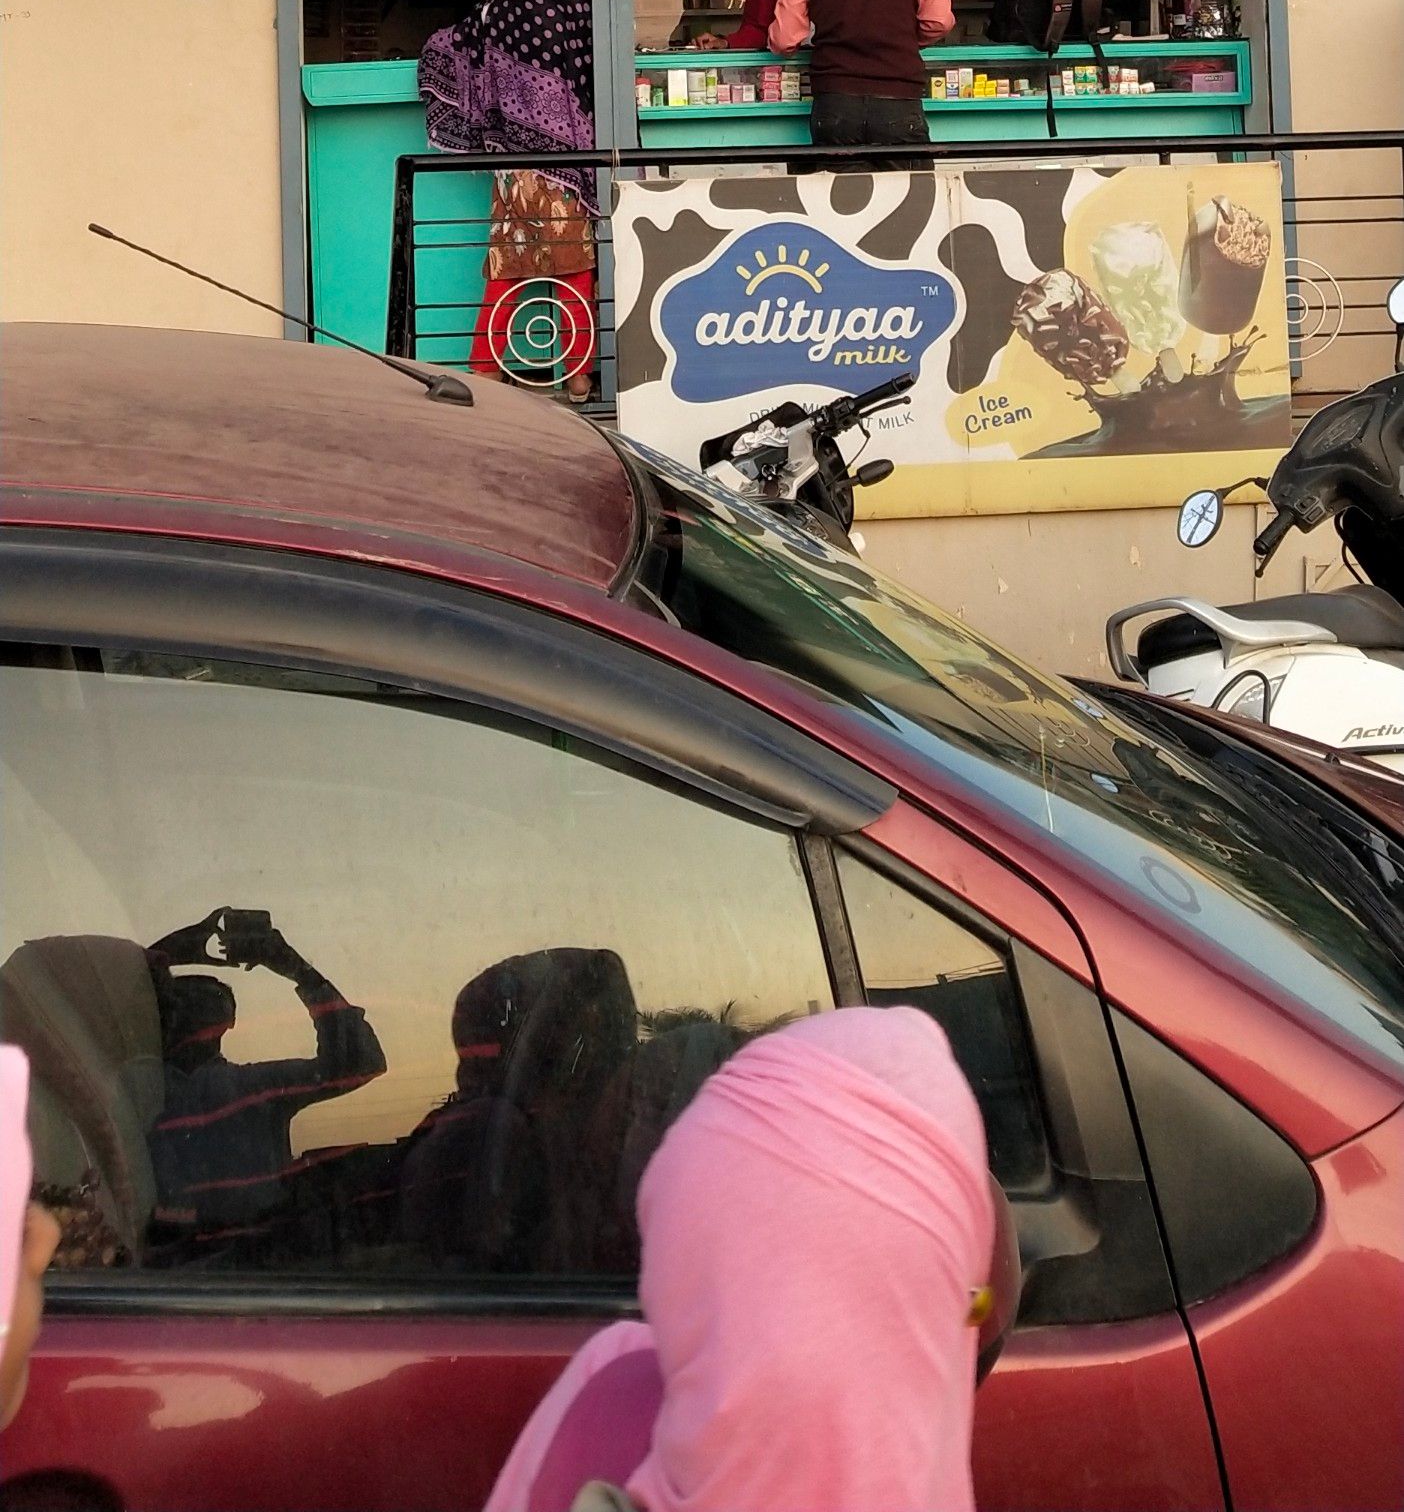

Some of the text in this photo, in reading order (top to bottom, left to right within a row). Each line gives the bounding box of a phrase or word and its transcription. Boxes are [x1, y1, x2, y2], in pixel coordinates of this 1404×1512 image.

[920, 286, 939, 296] TM
[696, 296, 923, 362] adityaa
[833, 345, 911, 365] milk
[978, 395, 1009, 413] Ice
[878, 411, 915, 429] MILK
[965, 407, 1032, 433] Cream
[1341, 724, 1404, 743] Activ
